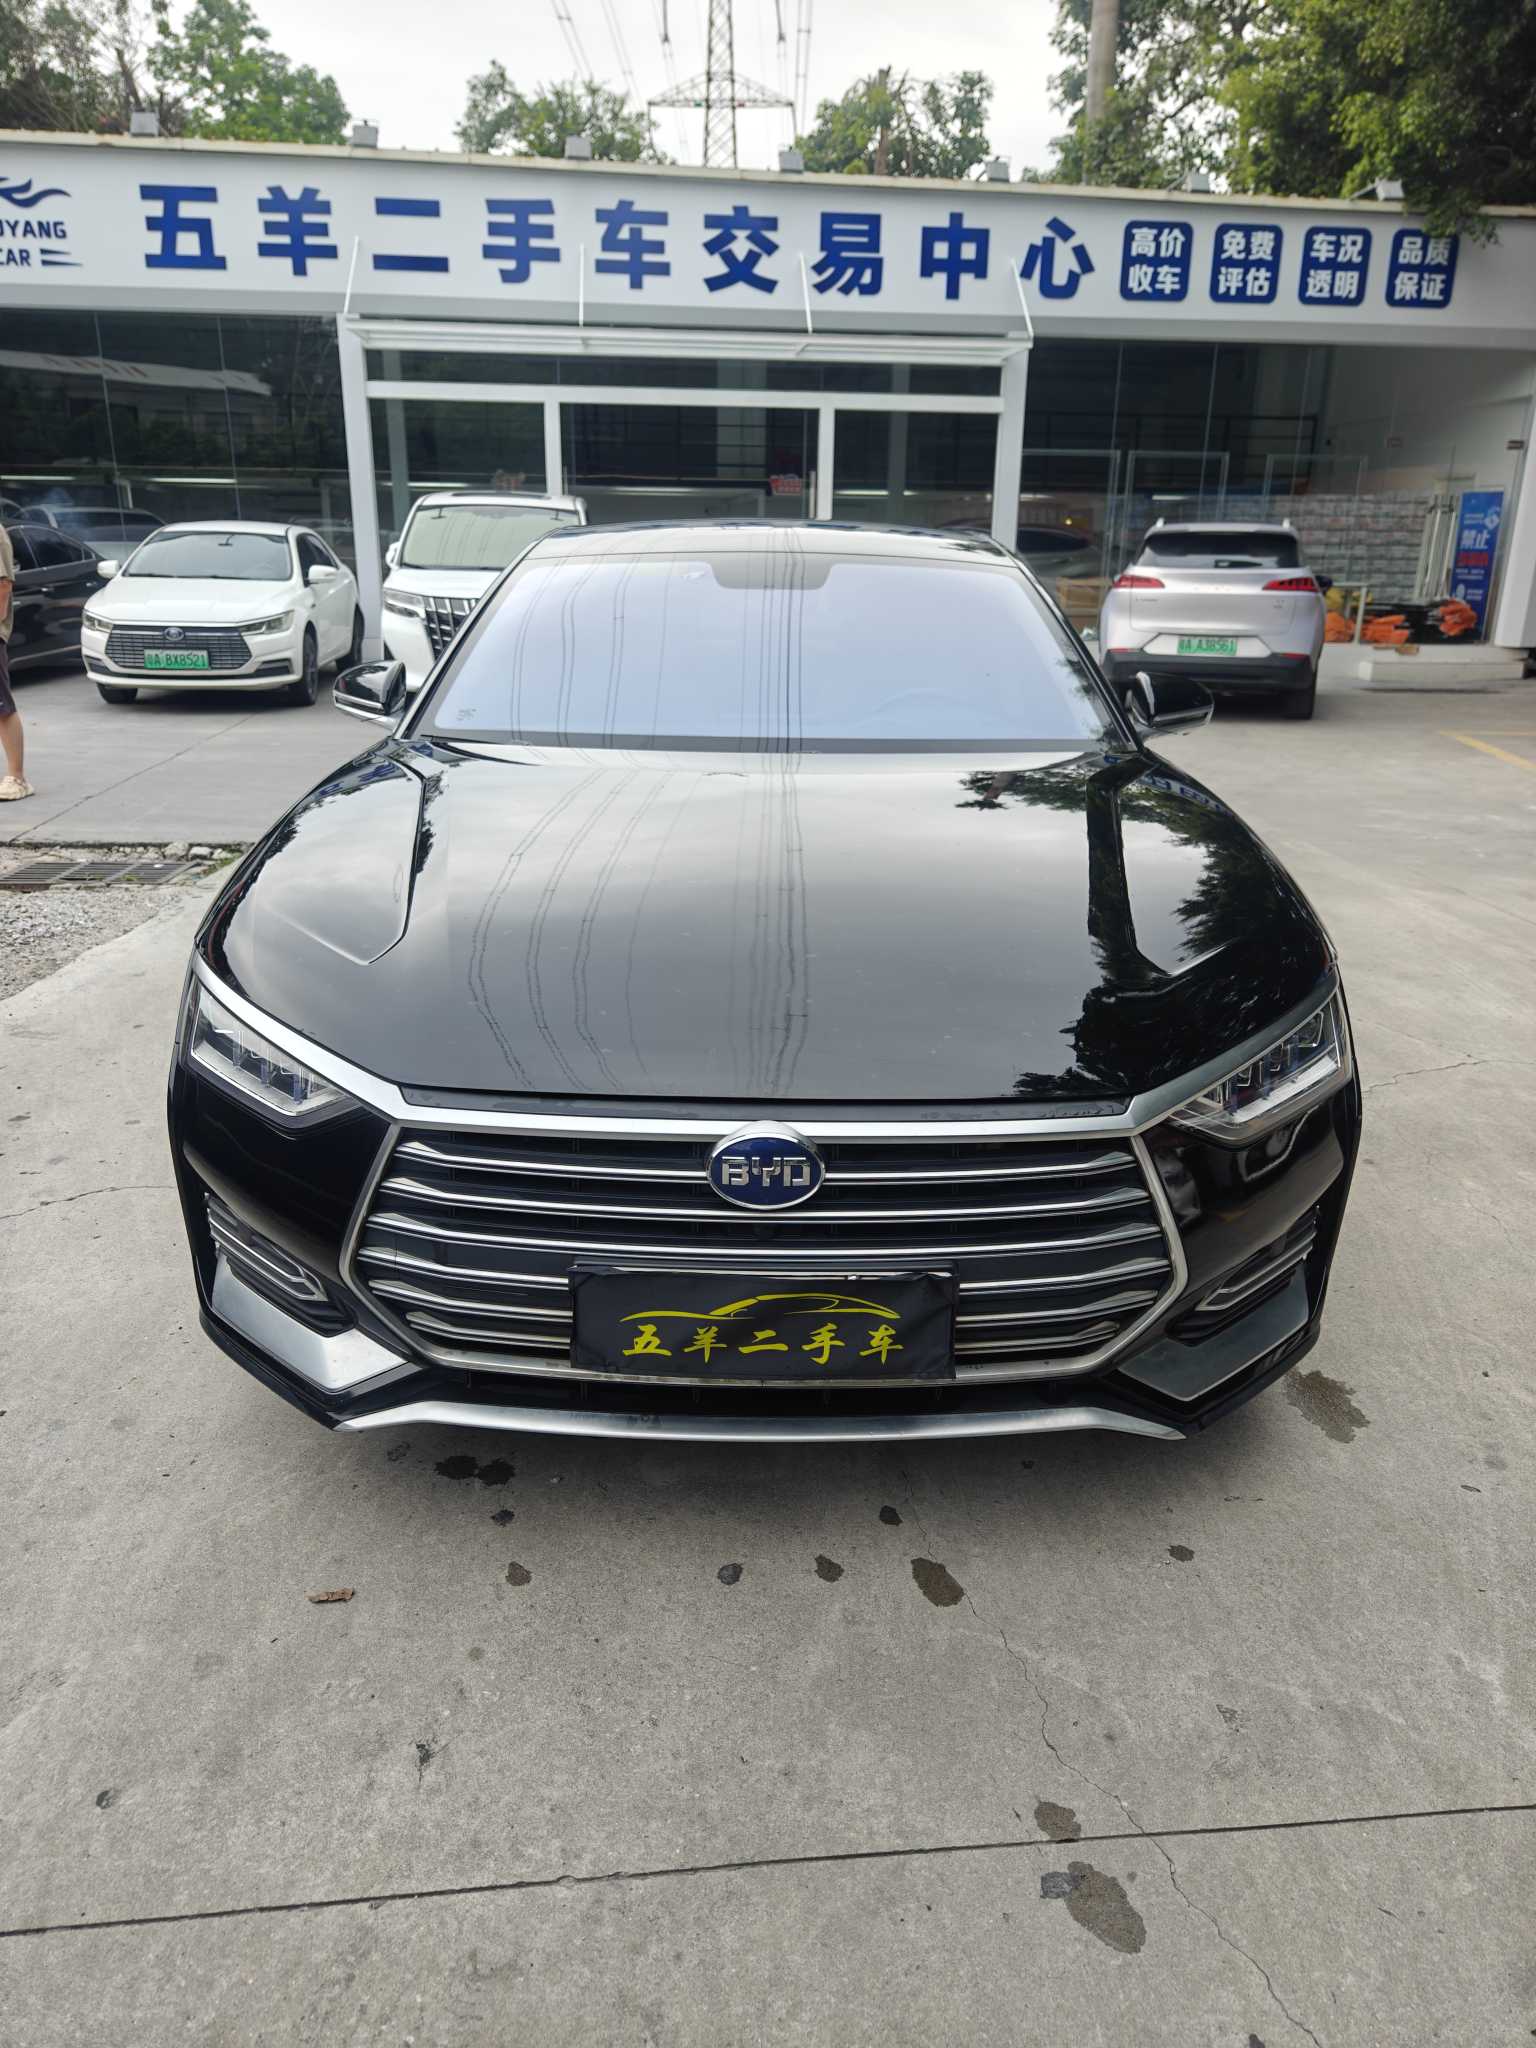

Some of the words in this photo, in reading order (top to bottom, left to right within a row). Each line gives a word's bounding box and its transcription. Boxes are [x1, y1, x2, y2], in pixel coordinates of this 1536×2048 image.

[139, 184, 1096, 301] 五羊二手车交易中心
[1130, 227, 1186, 258] 高价
[1220, 229, 1276, 261] 免费
[1309, 232, 1364, 264] 车况
[1398, 236, 1452, 266] 品质
[1127, 263, 1182, 295] 收车
[1217, 266, 1272, 297] 评估
[1305, 268, 1360, 300] 透明
[1393, 270, 1447, 301] 保证
[721, 1155, 812, 1188] BYD
[622, 1322, 904, 1366] 五羊二手车
